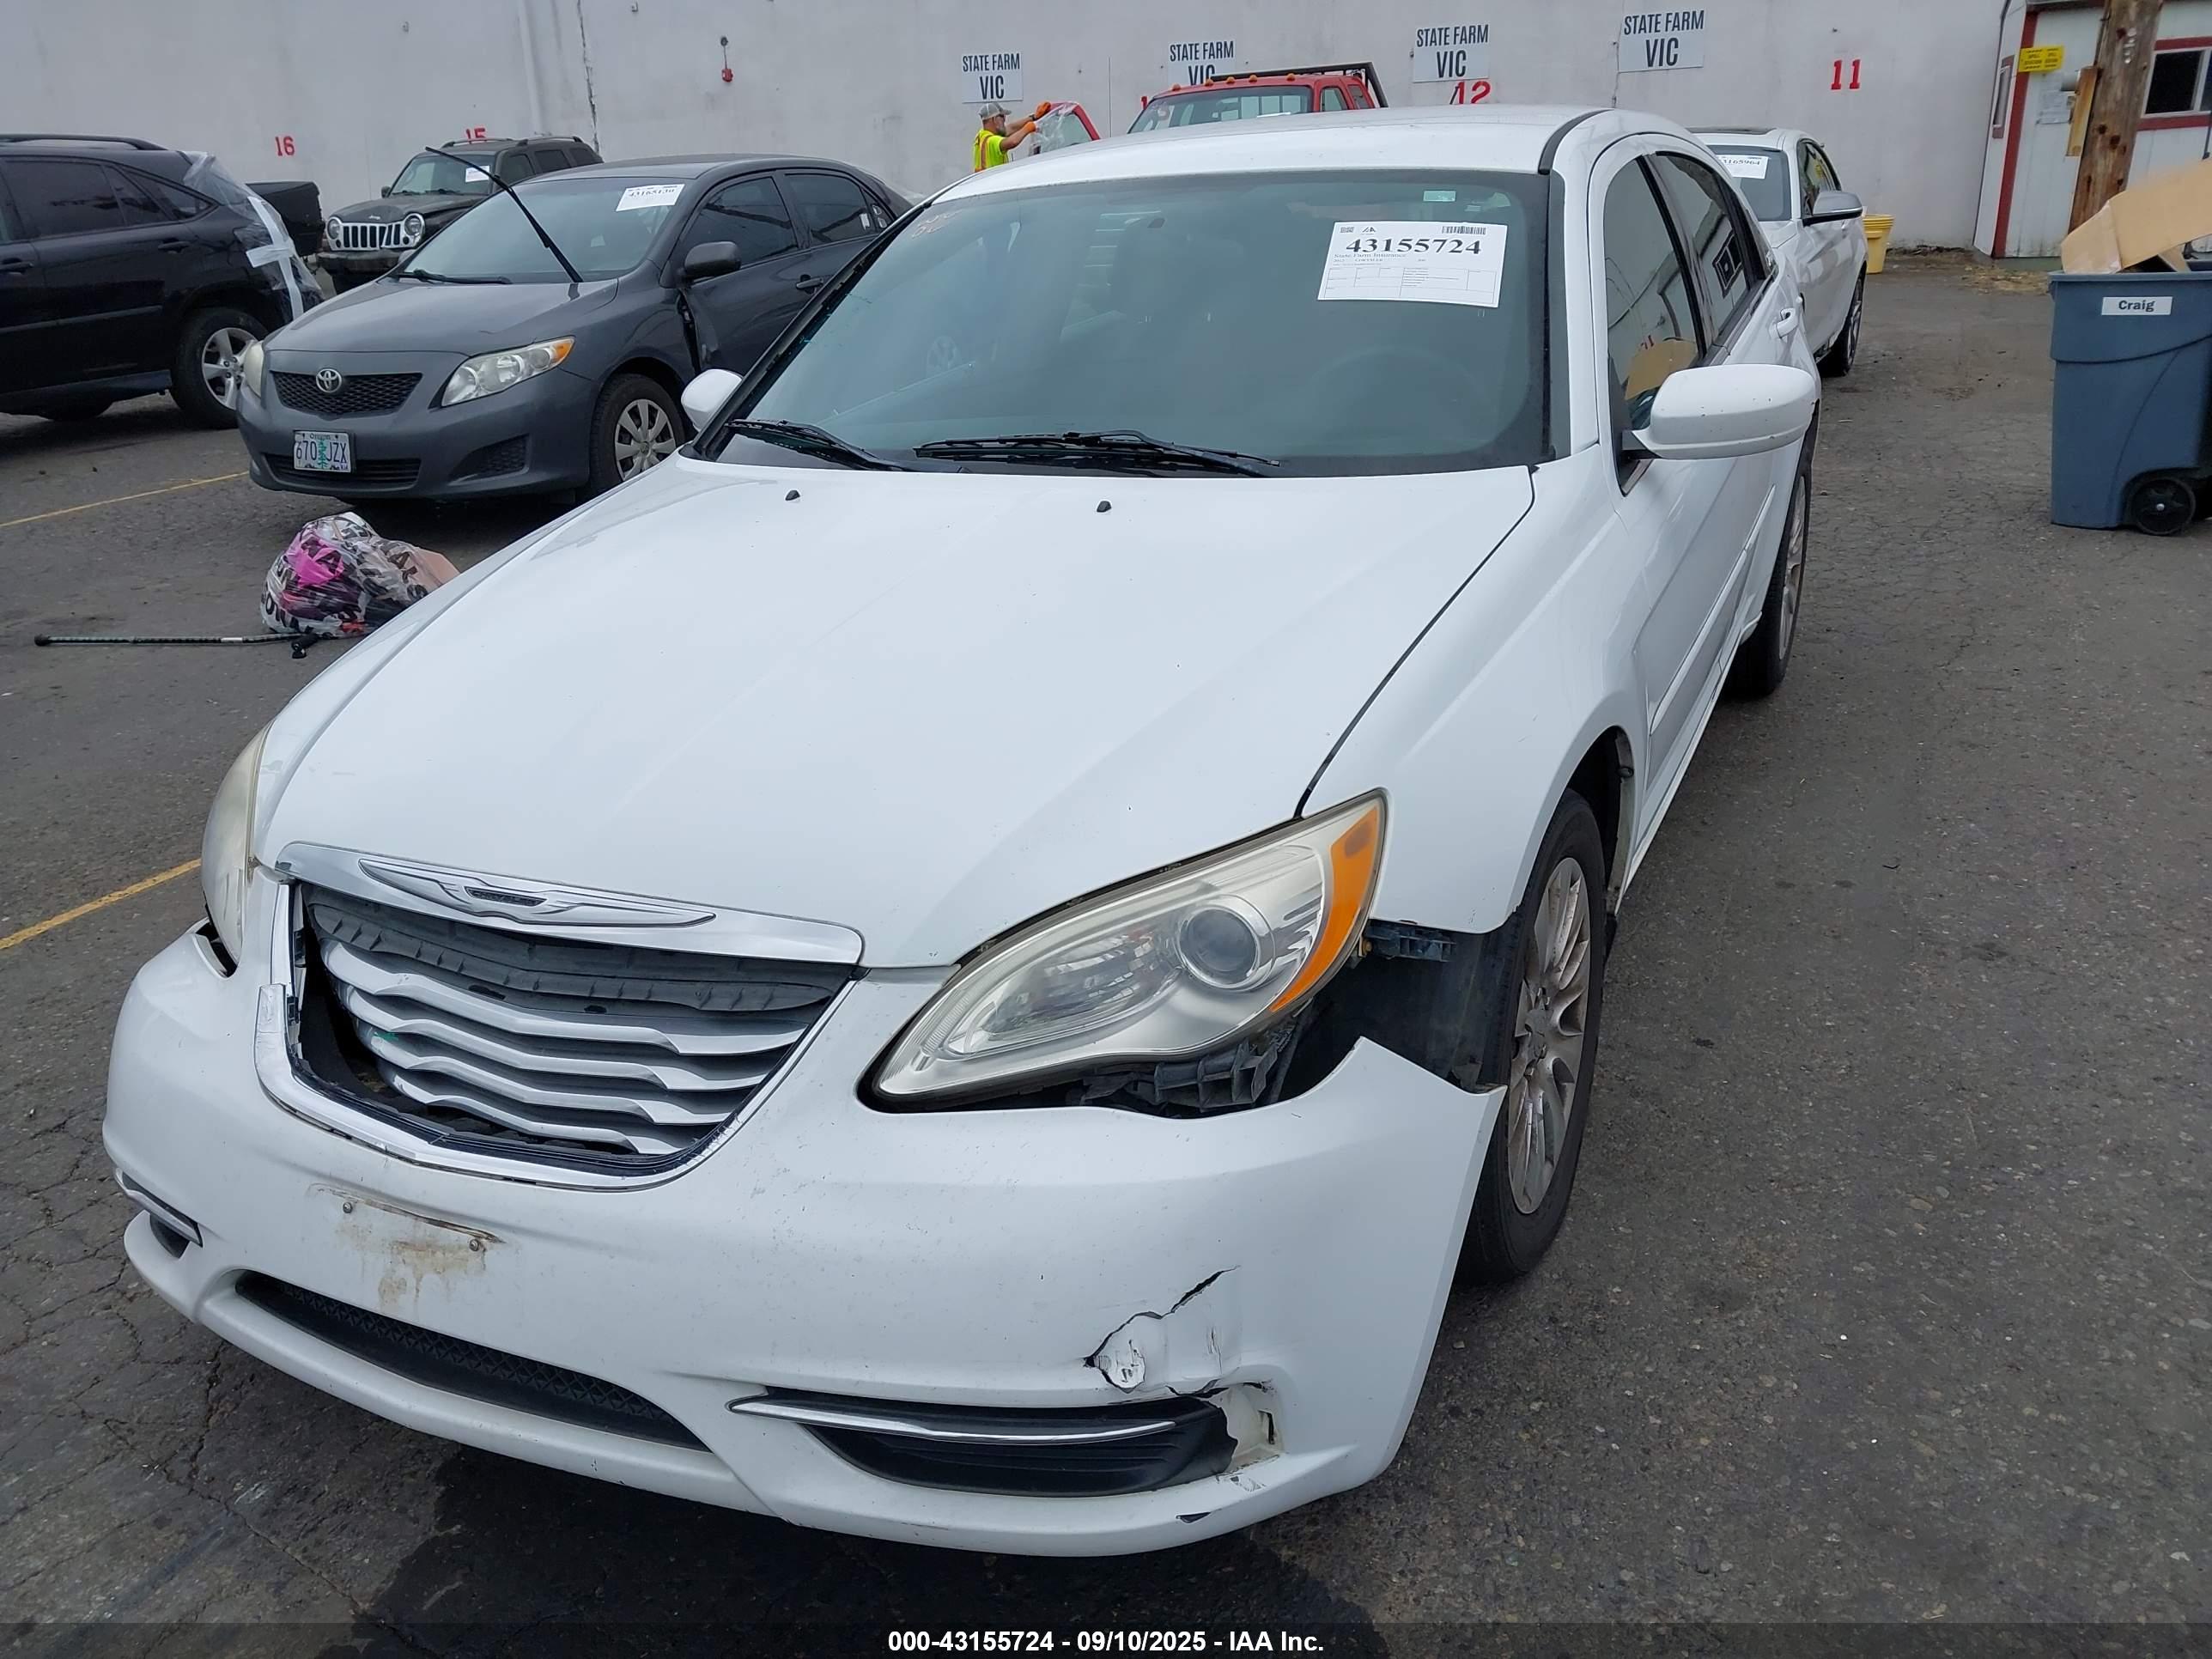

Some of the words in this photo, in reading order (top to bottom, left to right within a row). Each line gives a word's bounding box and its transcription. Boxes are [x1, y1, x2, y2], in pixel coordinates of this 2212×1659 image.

[1624, 14, 1662, 35] STATE
[1664, 9, 1705, 32] FARM
[1416, 27, 1450, 47] STATE
[1453, 24, 1489, 45] FARM
[963, 54, 990, 72] STATE
[992, 52, 1020, 70] FARM
[1170, 43, 1200, 62] STATE
[1203, 40, 1234, 59] FARM
[1645, 37, 1679, 67] VIC
[1436, 50, 1467, 78] VIC
[1831, 59, 1861, 90] 11
[980, 75, 1004, 100] VIC
[1456, 81, 1492, 105] 12
[275, 136, 295, 156] 16
[1346, 238, 1482, 255] 43155724
[2118, 300, 2156, 313] Craig
[296, 440, 318, 461] 670
[325, 441, 348, 464] JZX
